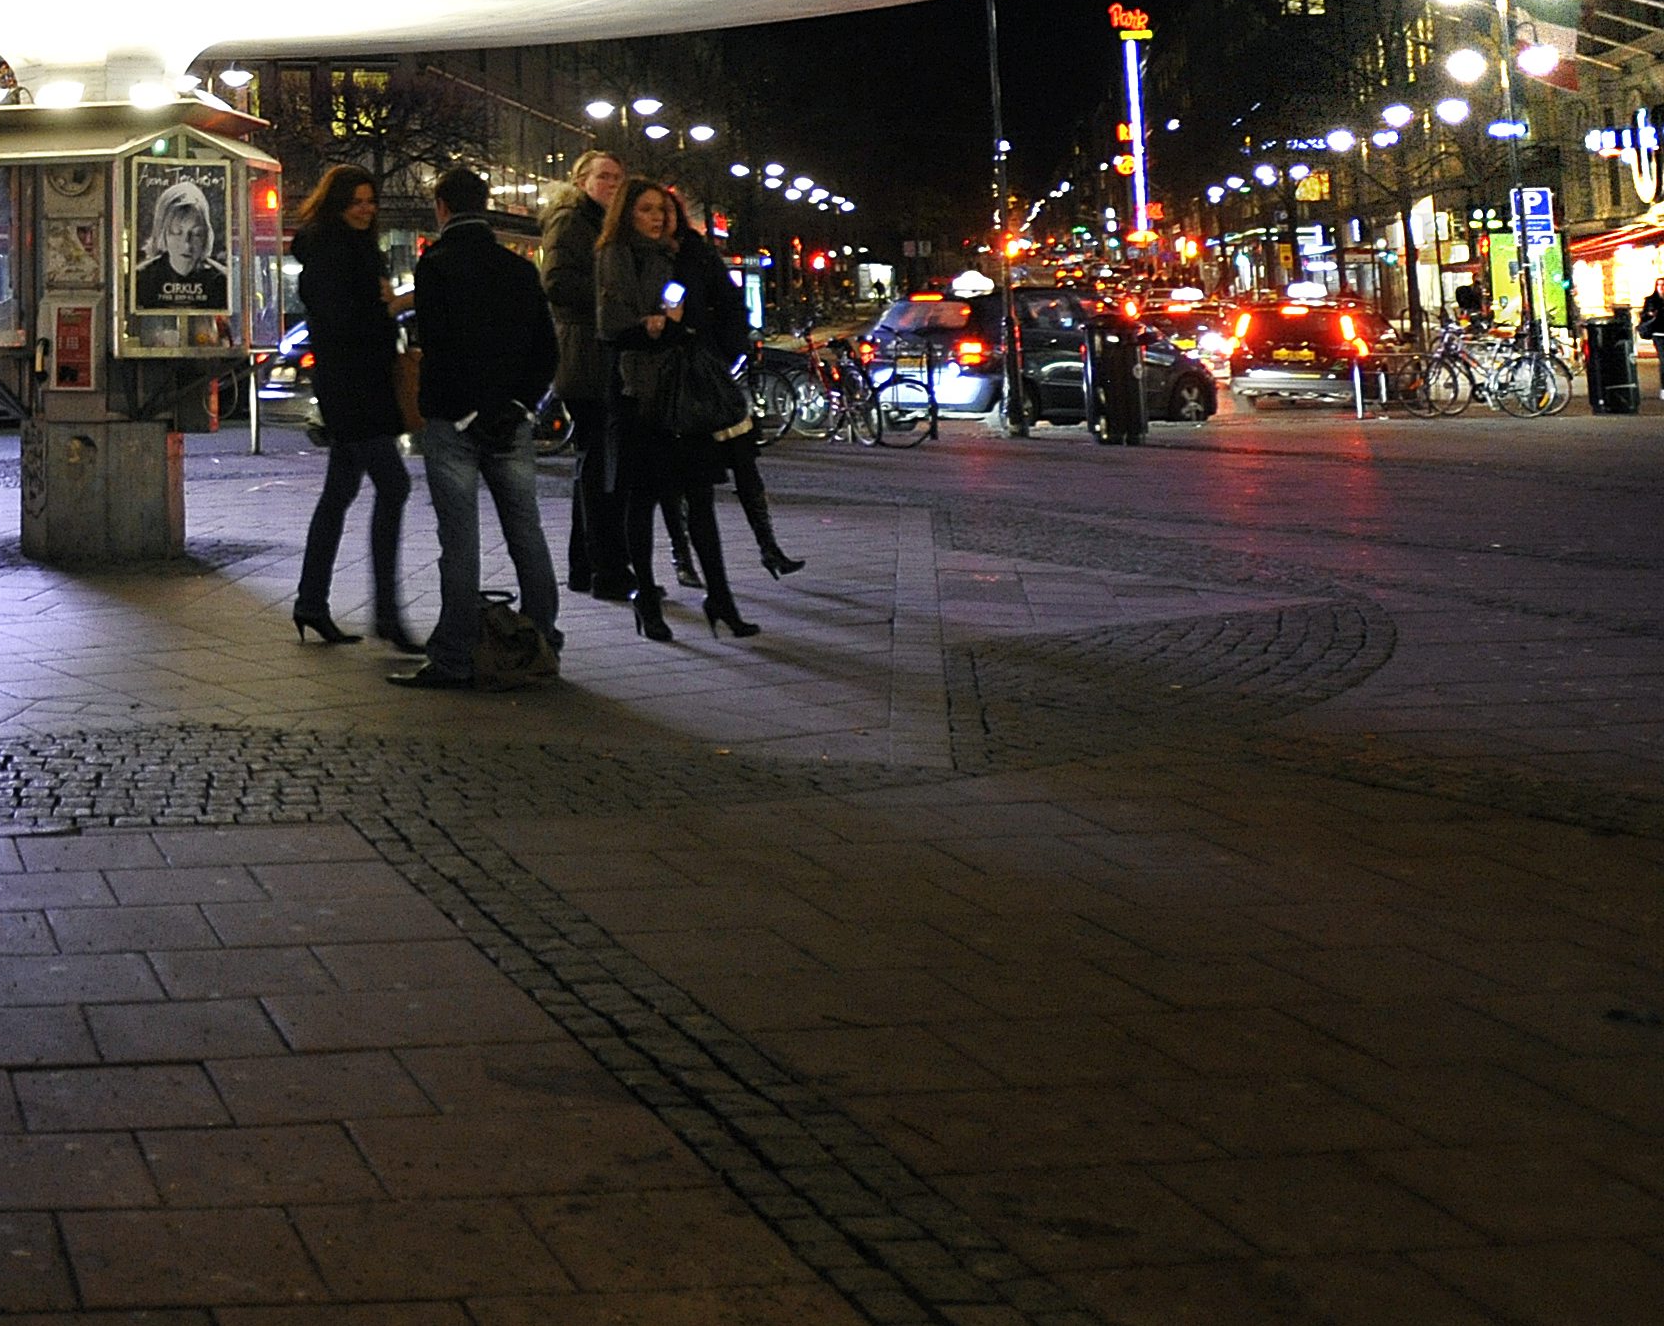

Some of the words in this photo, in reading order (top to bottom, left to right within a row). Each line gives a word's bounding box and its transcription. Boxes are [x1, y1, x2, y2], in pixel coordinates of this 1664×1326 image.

[1108, 3, 1148, 30] Park
[1522, 192, 1543, 215] P
[163, 282, 203, 294] CIRKUS
